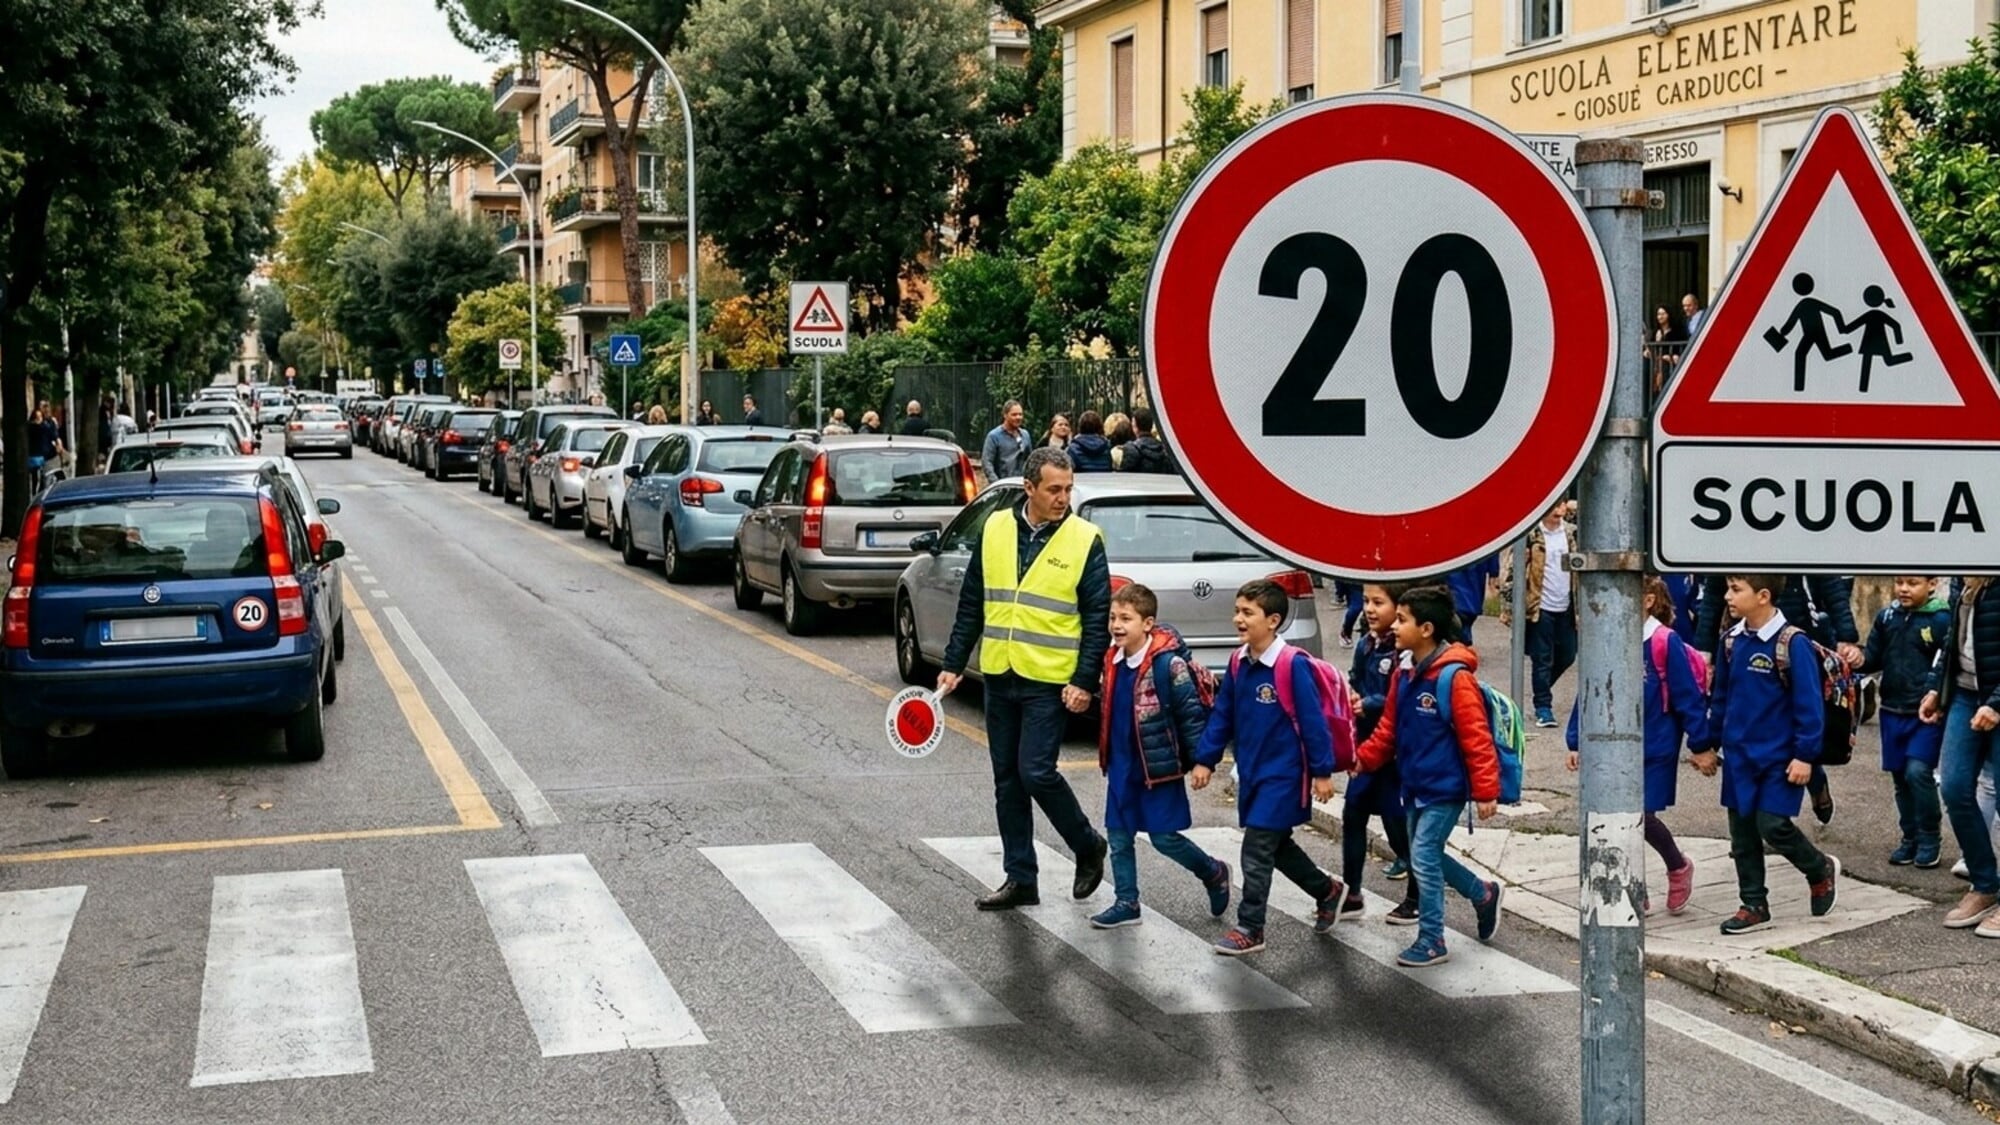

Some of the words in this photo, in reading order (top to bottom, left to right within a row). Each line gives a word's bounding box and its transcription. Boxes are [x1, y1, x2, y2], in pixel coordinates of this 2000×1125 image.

[1510, 55, 1611, 103] SCUOLA
[1637, 0, 1857, 78] ELEMENTARE
[1656, 65, 1763, 105] CARDUCCI
[1258, 231, 1513, 439] 20
[1690, 477, 1986, 533] SCUOLA
[240, 605, 262, 621] 20
